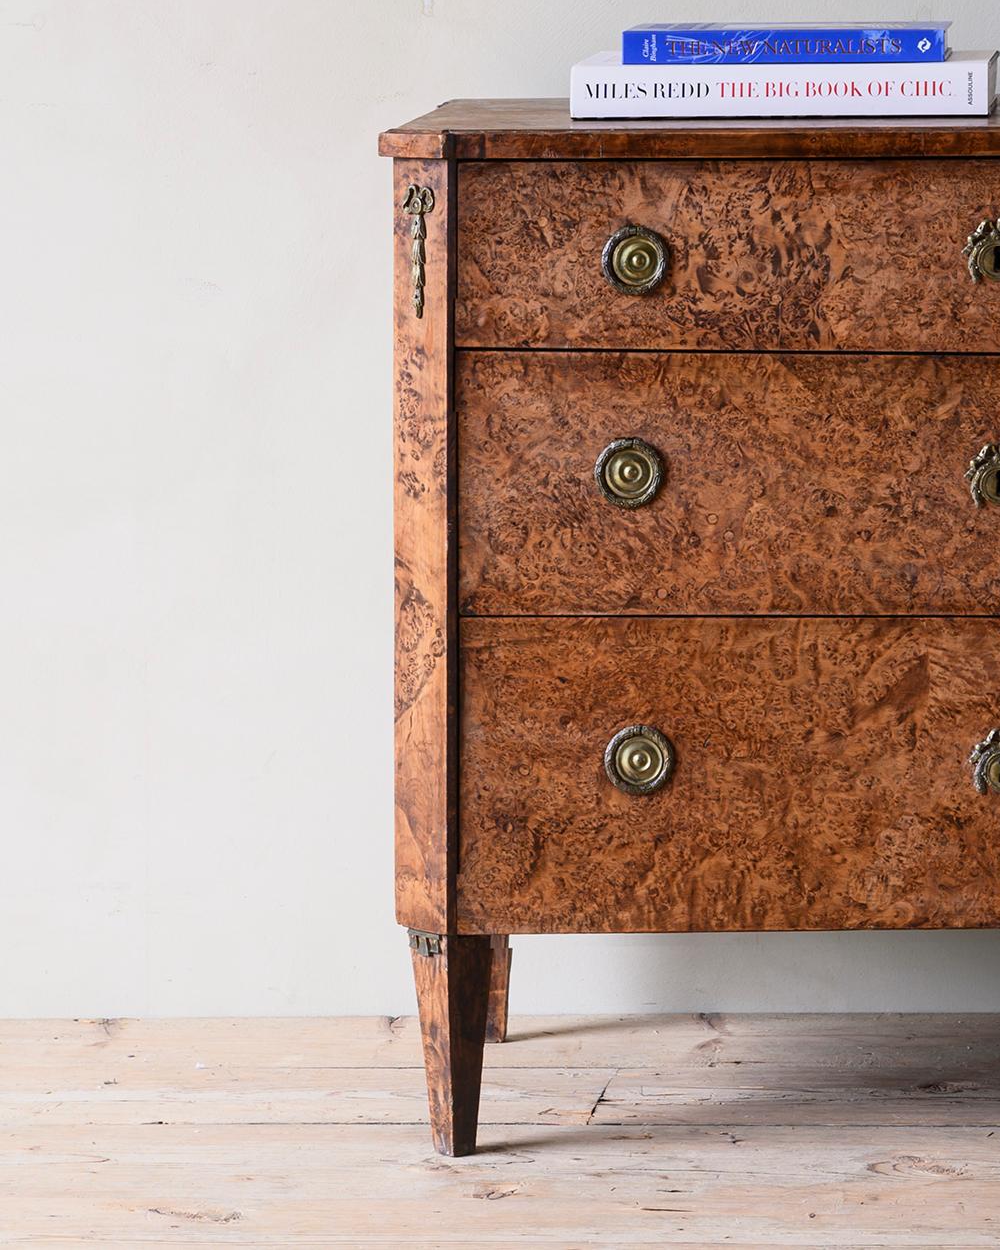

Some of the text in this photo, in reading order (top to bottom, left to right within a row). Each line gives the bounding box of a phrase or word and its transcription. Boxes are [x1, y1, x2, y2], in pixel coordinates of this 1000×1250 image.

[666, 38, 902, 56] THE NEW NATURALISTS
[584, 80, 953, 99] MILES REDD THE BIG BOOK OF CHIC
